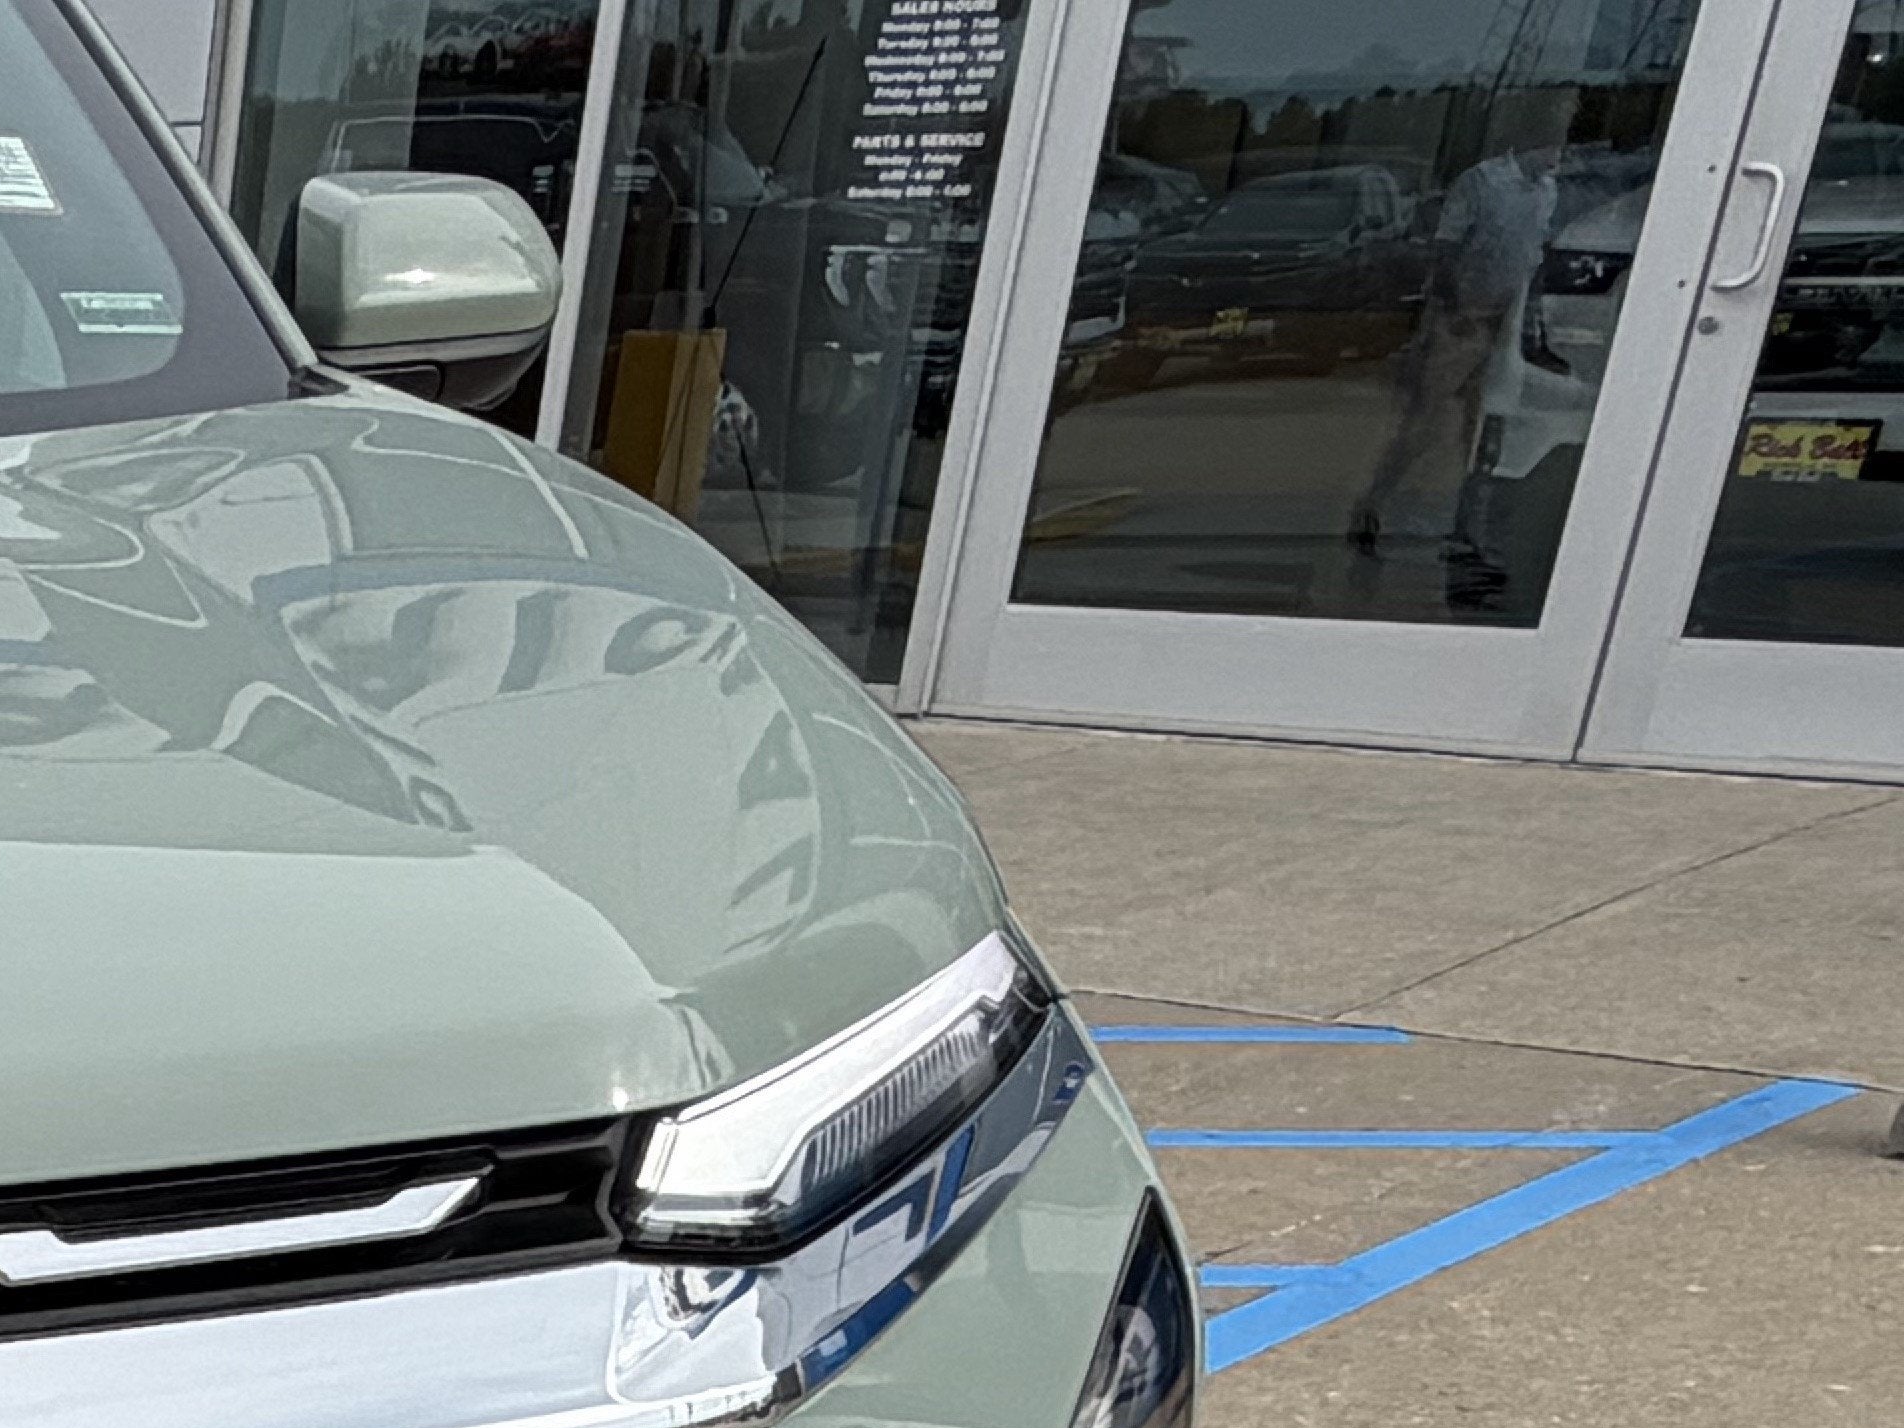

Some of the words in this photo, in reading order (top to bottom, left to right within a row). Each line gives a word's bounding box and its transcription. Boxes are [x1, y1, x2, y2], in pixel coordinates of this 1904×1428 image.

[891, 1, 940, 15] SALES
[852, 134, 901, 149] PARTS
[919, 132, 986, 148] SERVICE
